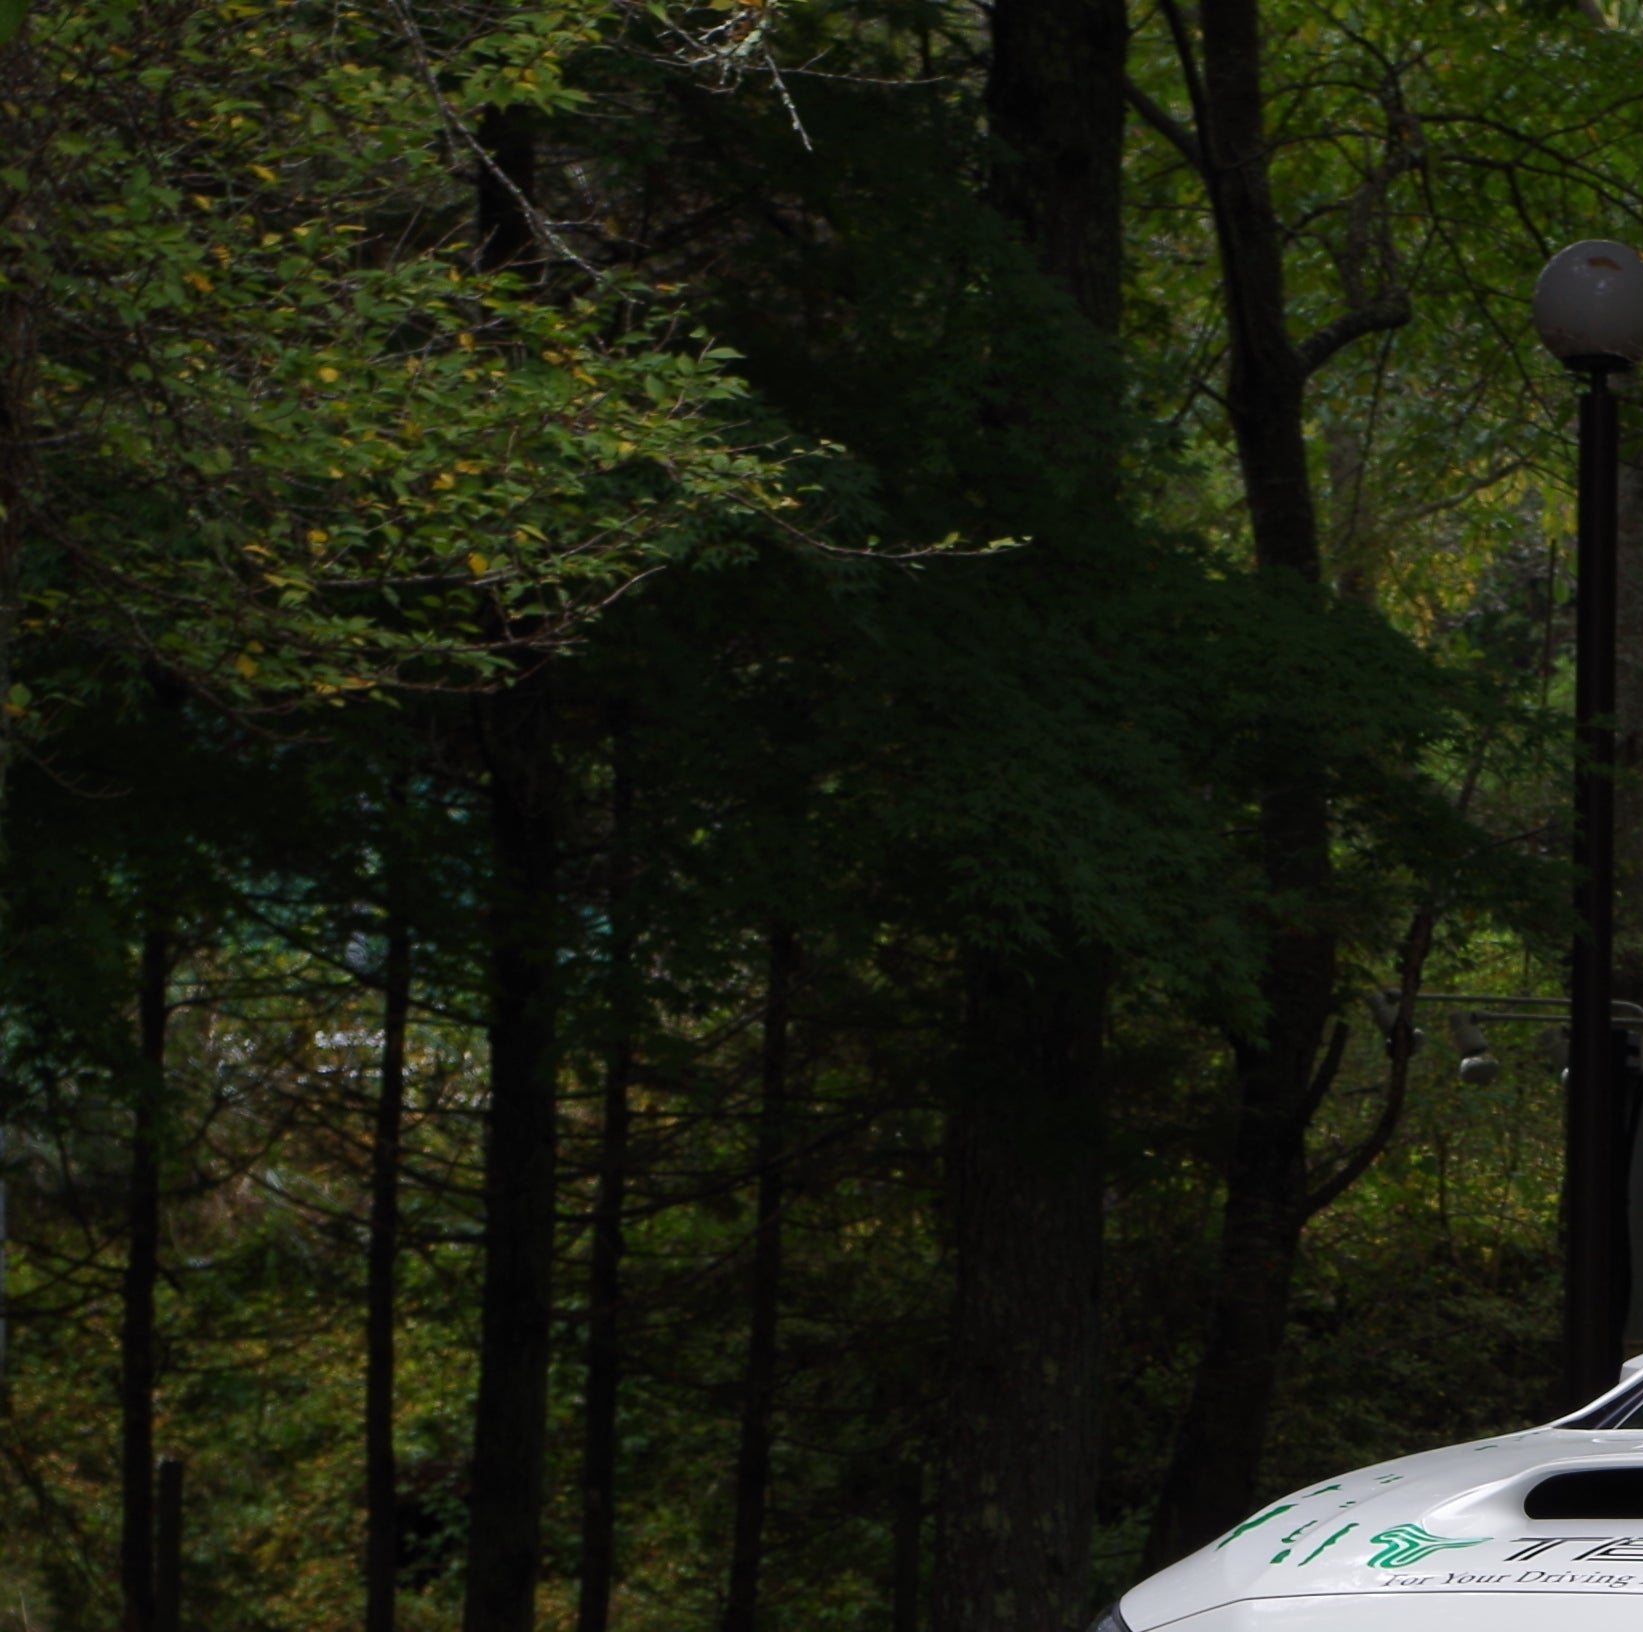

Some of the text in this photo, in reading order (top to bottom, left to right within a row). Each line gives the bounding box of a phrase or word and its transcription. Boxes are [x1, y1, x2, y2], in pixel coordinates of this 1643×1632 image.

[1381, 1571, 1427, 1588] For
[1440, 1571, 1513, 1588] Your
[1517, 1570, 1630, 1590] Driving
